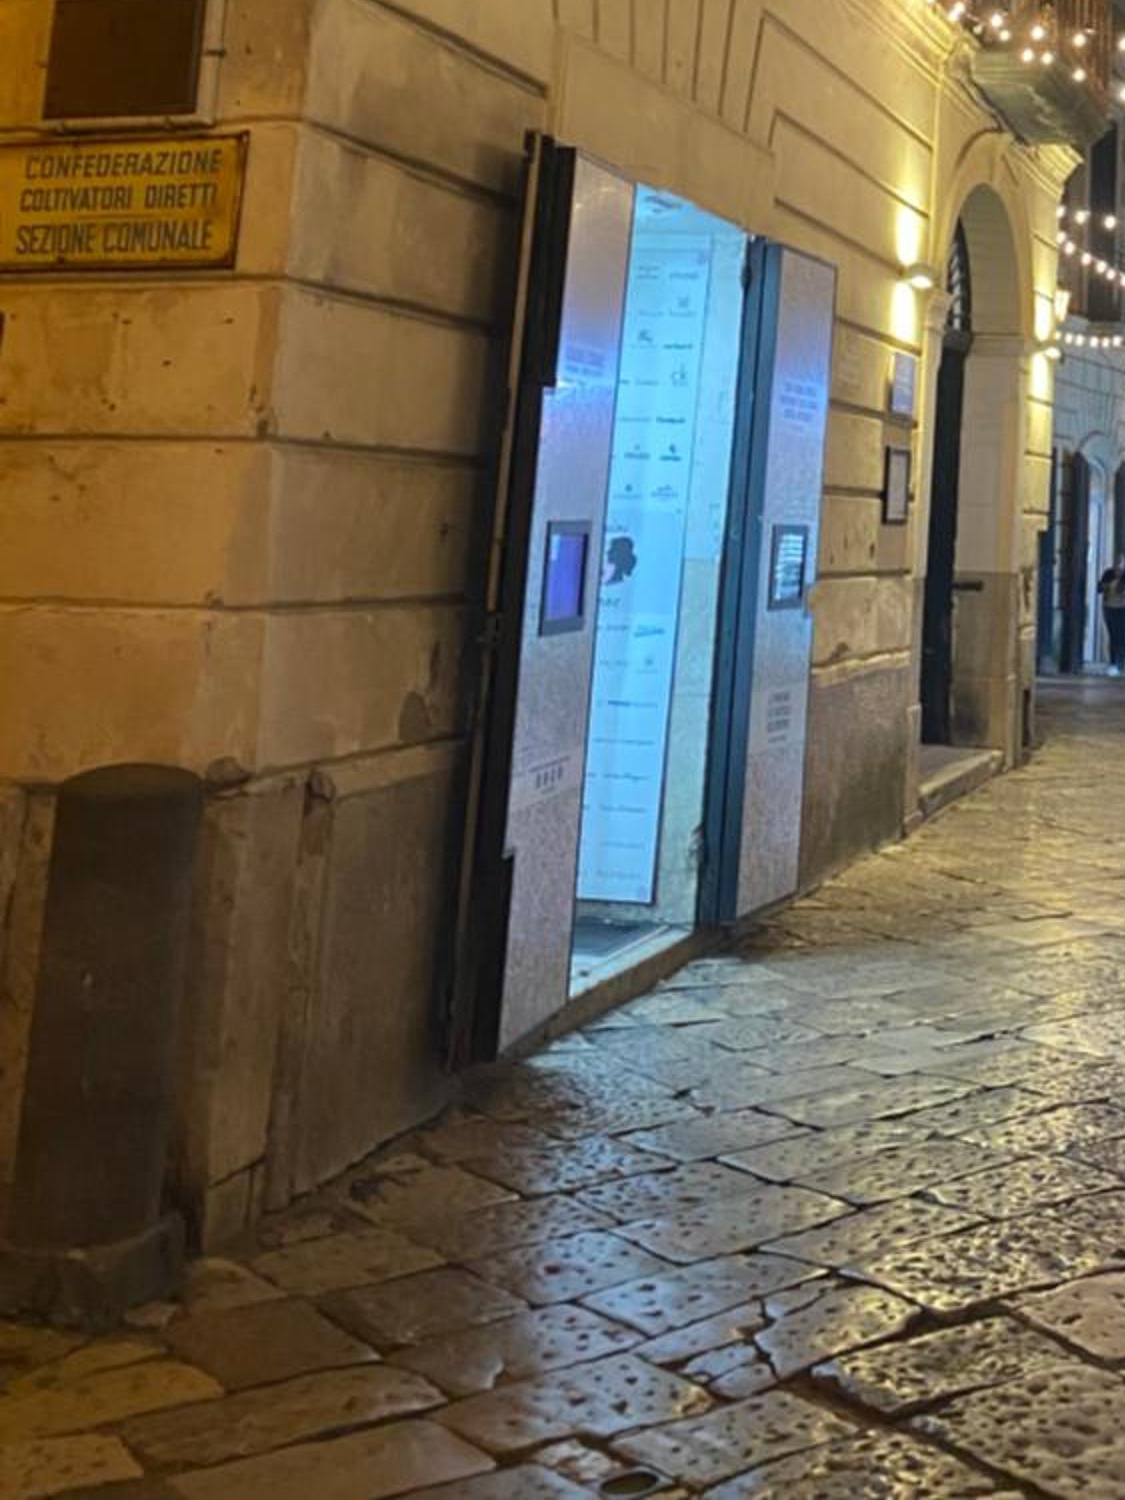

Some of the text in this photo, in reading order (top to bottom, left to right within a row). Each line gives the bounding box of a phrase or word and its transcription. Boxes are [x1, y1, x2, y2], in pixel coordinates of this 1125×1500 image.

[24, 148, 223, 180] CONFEDERAZIONE
[19, 182, 218, 212] COLTIVATORI DIRETTI
[15, 218, 214, 254] SEZIONE COMUNALE
